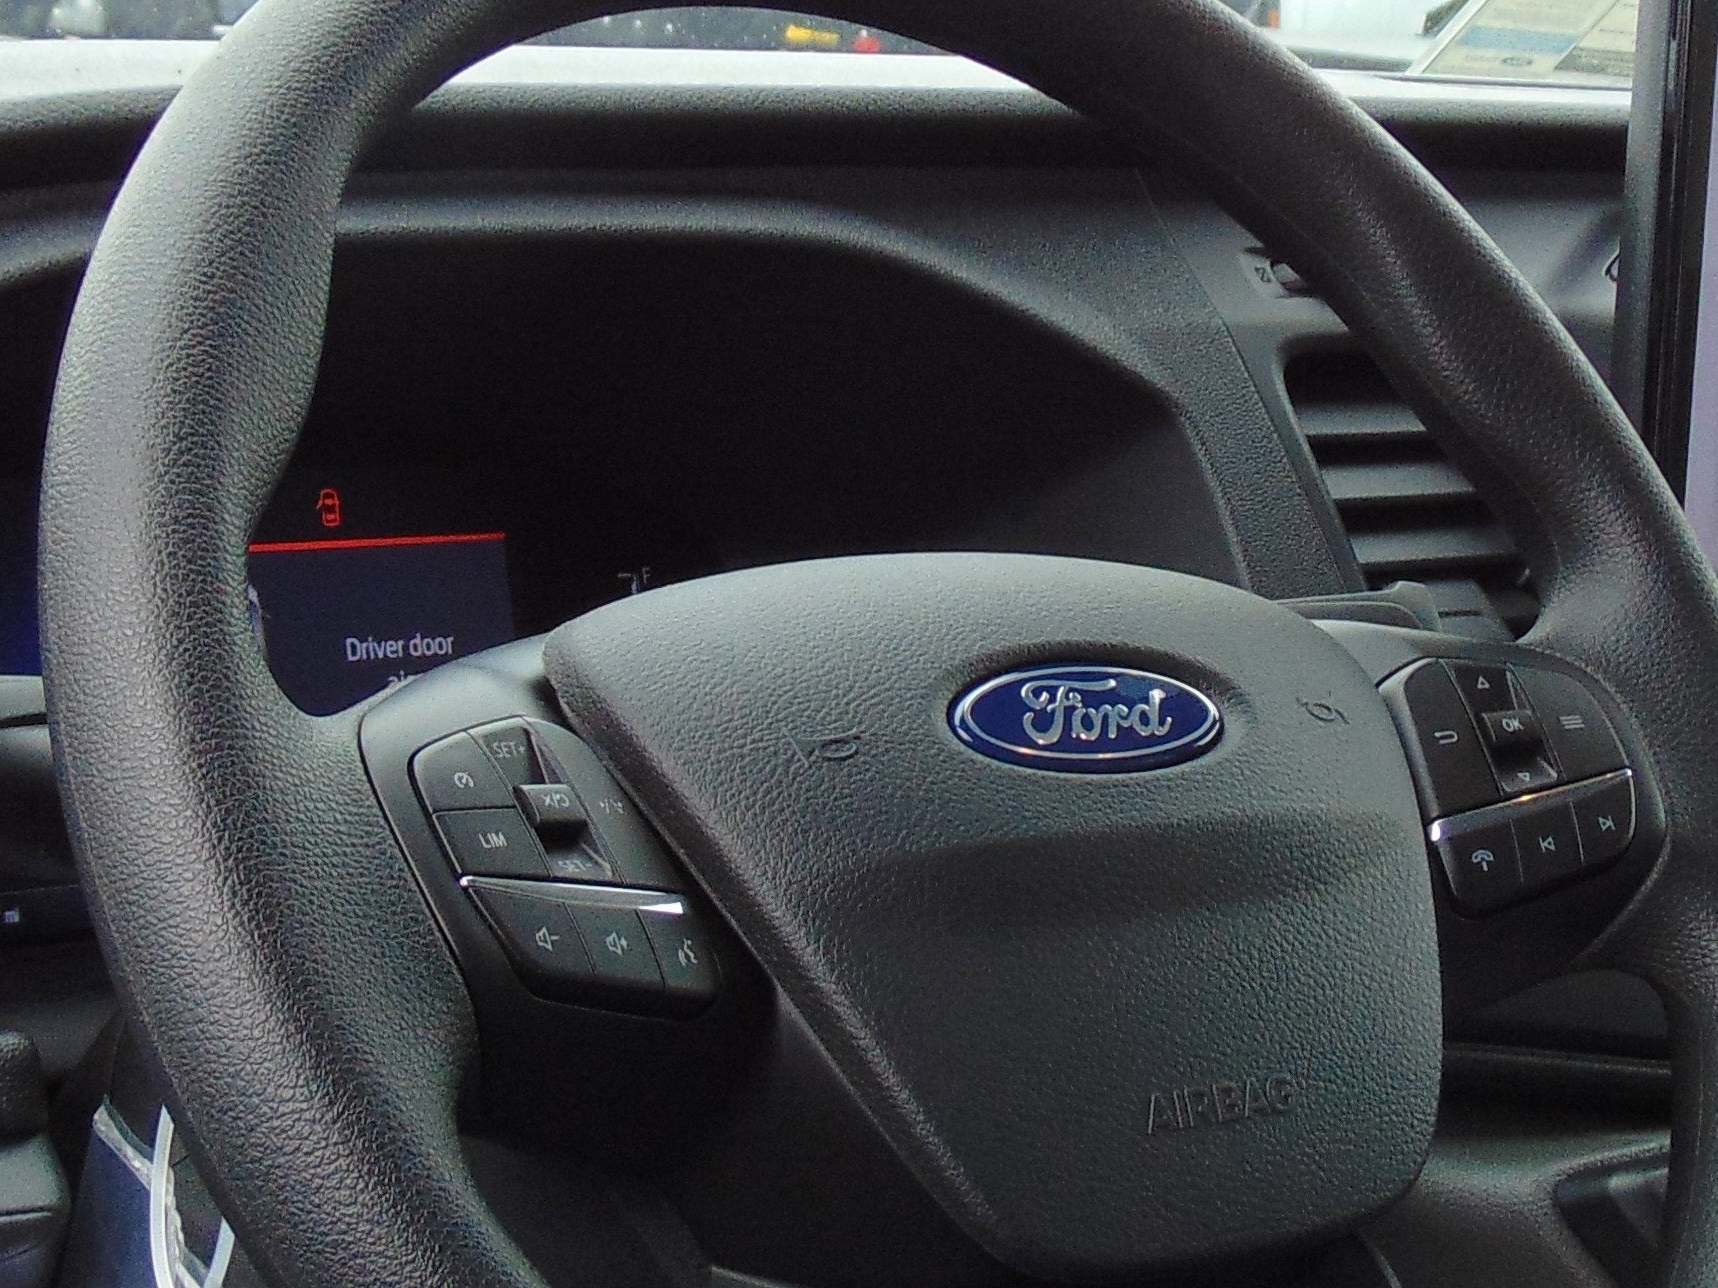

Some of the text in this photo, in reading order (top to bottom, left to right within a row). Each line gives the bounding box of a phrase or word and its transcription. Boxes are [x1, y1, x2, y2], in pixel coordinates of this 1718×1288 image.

[345, 632, 455, 662] Driver door
[1021, 678, 1173, 744] Ford
[1501, 715, 1525, 734] OK
[492, 739, 526, 760] SET+
[478, 831, 508, 849] LIM
[1147, 1074, 1296, 1136] AIRBAG
